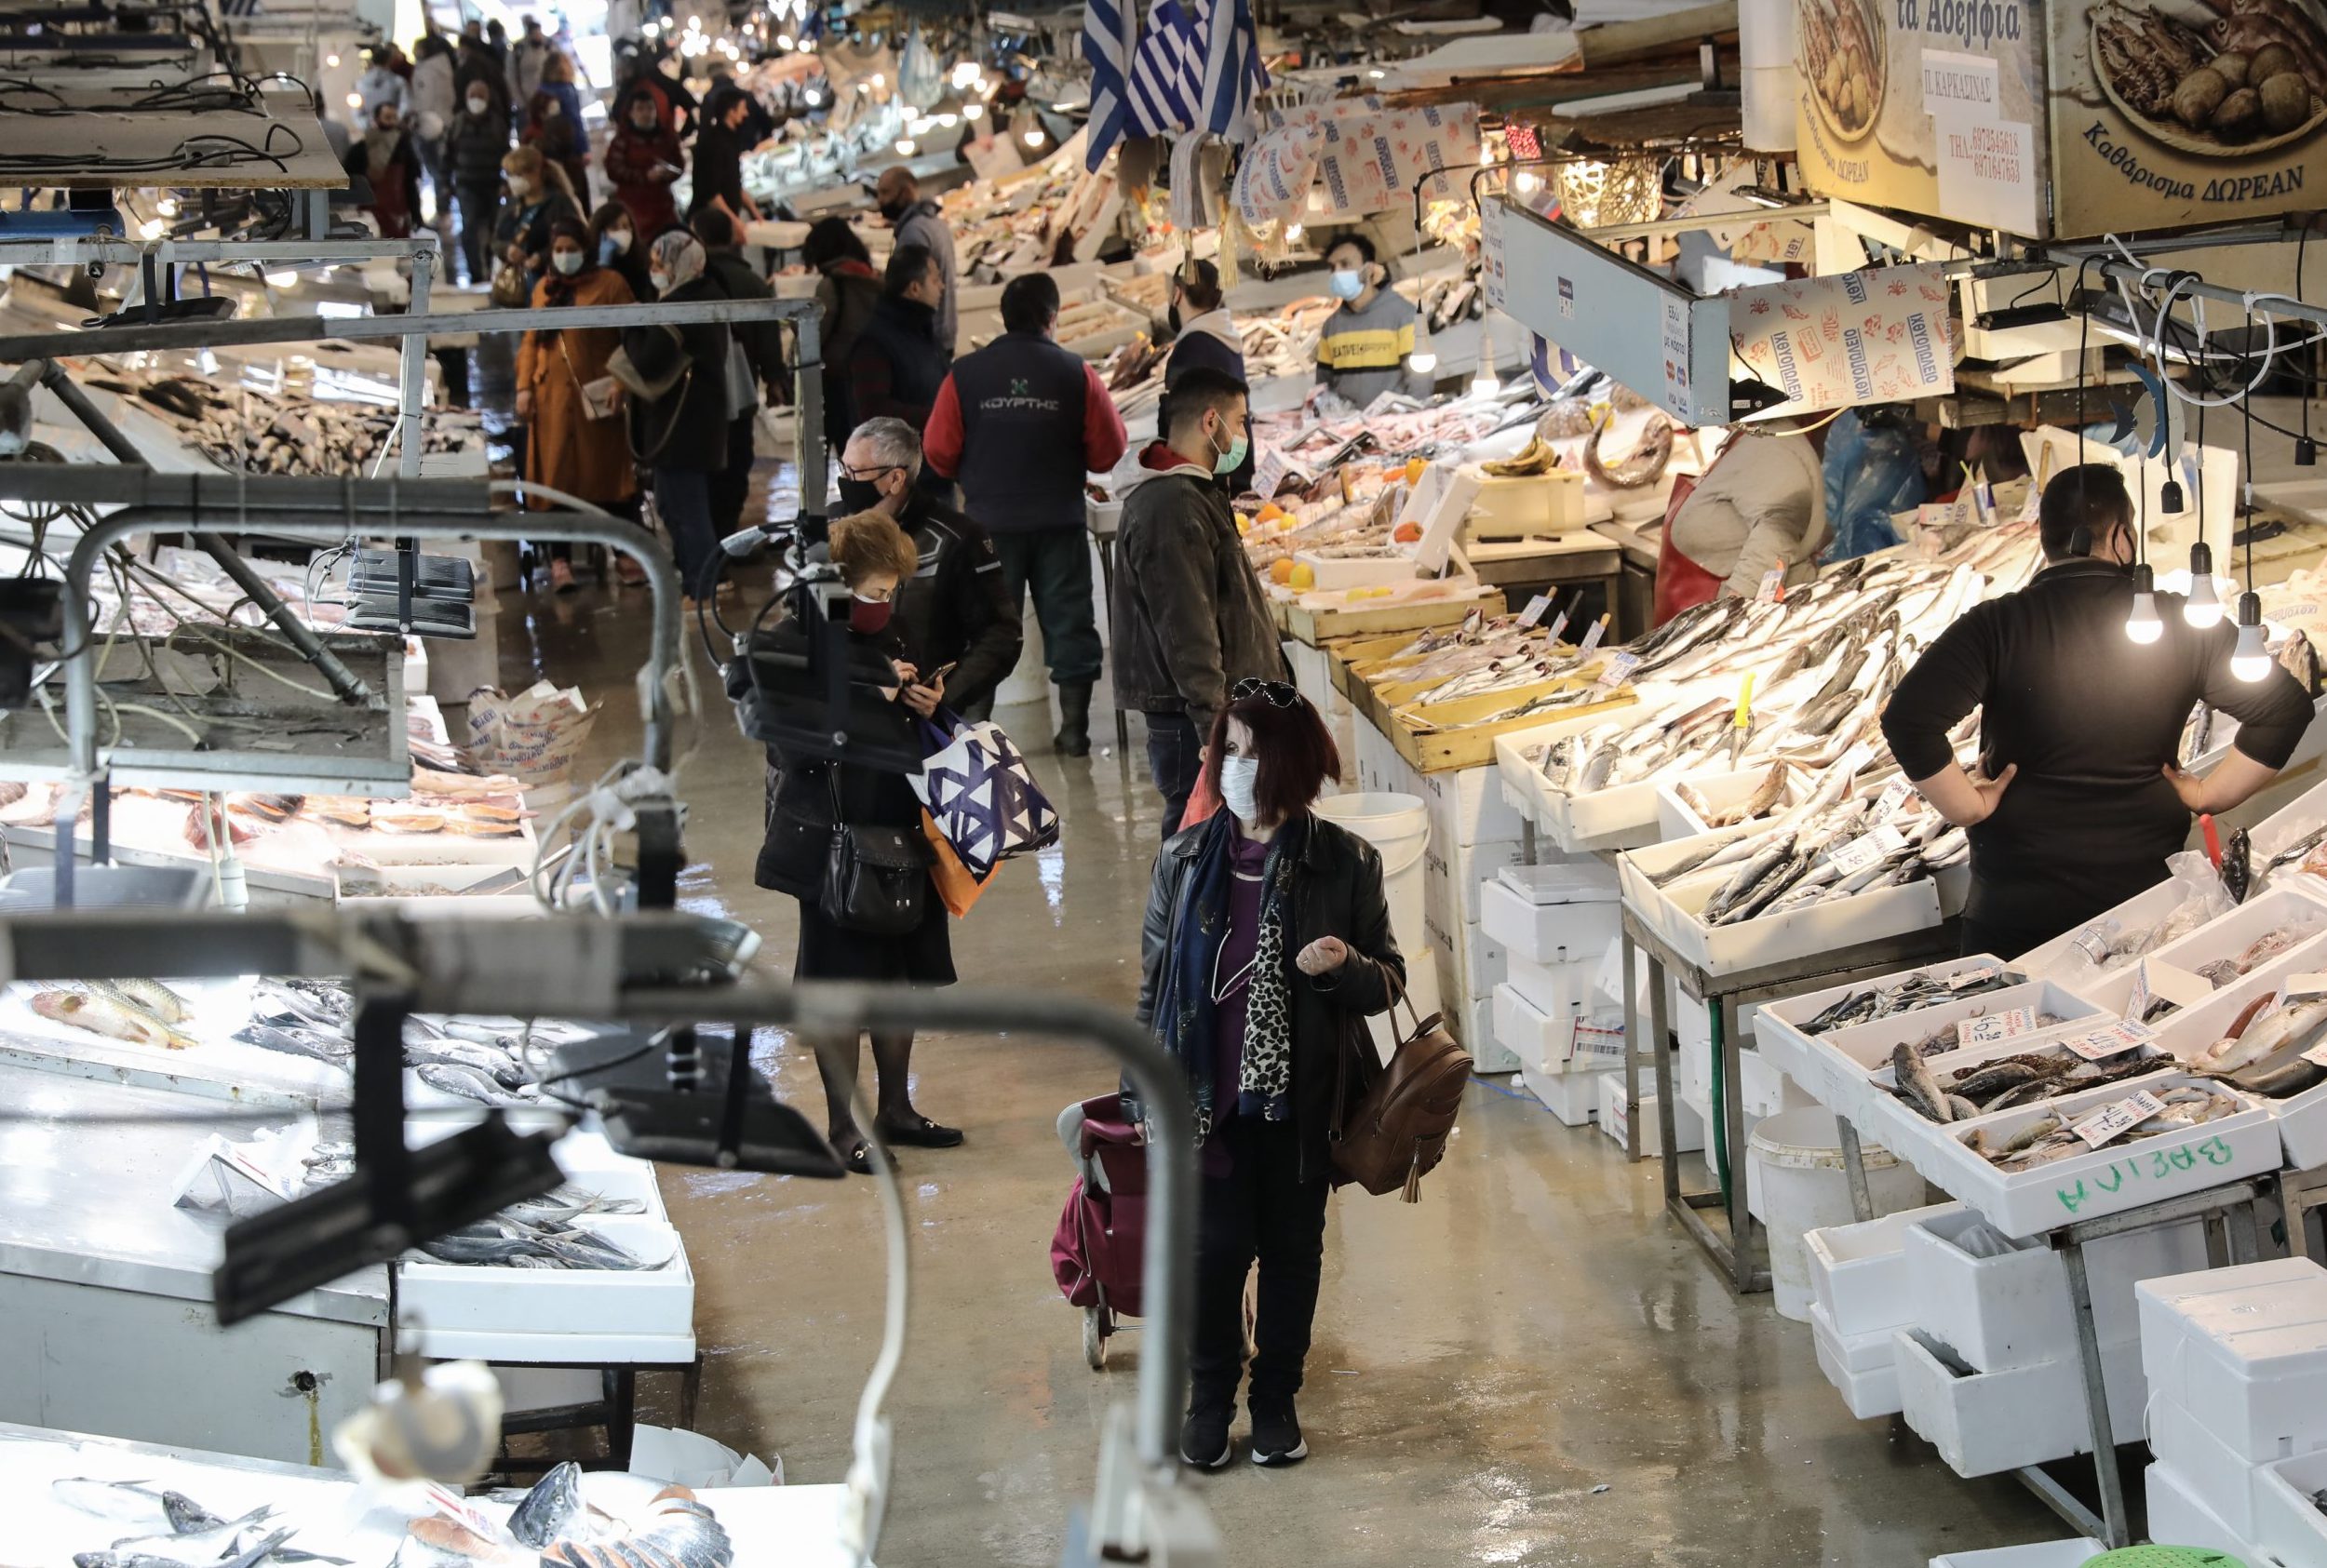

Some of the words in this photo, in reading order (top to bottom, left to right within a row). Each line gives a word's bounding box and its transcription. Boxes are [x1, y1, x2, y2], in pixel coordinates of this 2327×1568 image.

[1324, 155, 1348, 209] ΙΧΘΥΟΠΩΛΕΙΟ
[2082, 119, 2195, 199] Καθάρισμα
[2201, 165, 2305, 202] ΔΩΡΕΑΝ
[1772, 330, 1805, 404] ΙΧΘΥΟΠΩΛΕΙΟ
[1843, 328, 1872, 400] ΙΧΘΥΟΠΩΛΕΙΟ
[1909, 313, 1940, 384] ΙΧΘΥΟΠΩΛΕΙΟ
[979, 396, 1059, 411] ΚΟΥΡΤΗΣ
